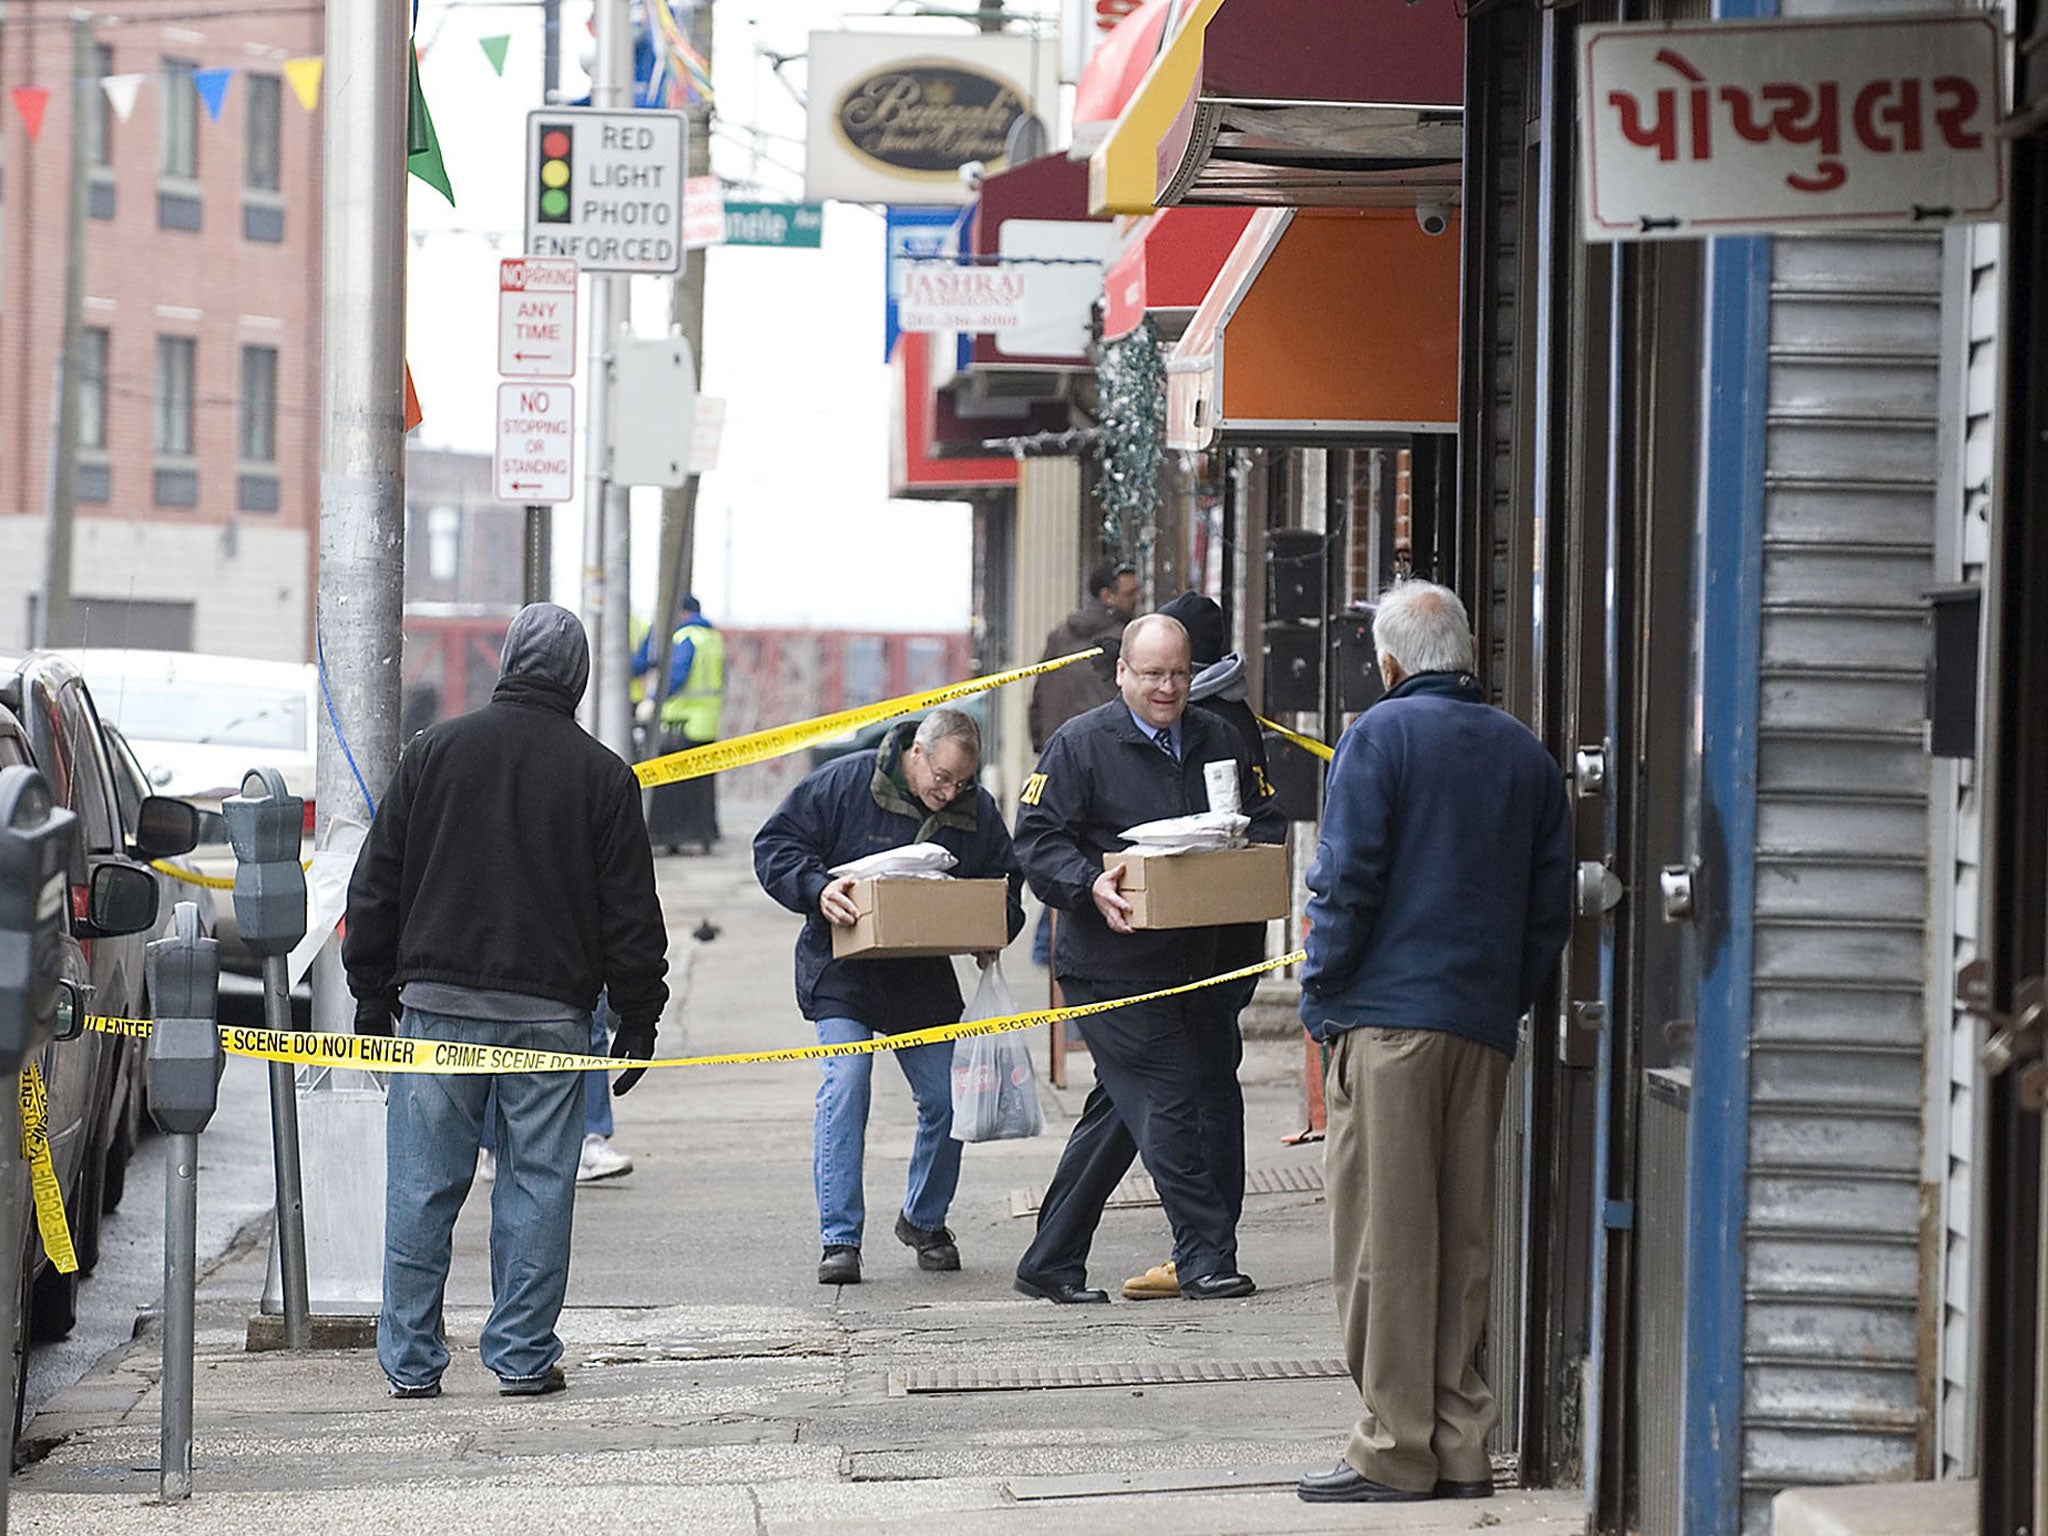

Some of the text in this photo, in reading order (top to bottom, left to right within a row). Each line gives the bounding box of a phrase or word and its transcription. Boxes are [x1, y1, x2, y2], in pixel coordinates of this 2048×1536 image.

[1609, 48, 1983, 192] પોપ્યુલર
[602, 124, 655, 150] RED
[590, 163, 664, 188] LIGHT
[582, 199, 671, 226] PHOTO
[533, 234, 673, 262] ENFORCED
[502, 263, 575, 287] NO PARKING
[903, 272, 1025, 299] JASHRAJ
[517, 302, 557, 318] ANY
[514, 322, 561, 339] TIME
[520, 391, 551, 413] NO
[503, 418, 568, 434] STOPPING
[525, 439, 545, 454] OR
[503, 459, 567, 475] STANDING
[233, 1030, 289, 1053] SCENE
[294, 1035, 316, 1054] DO
[322, 1036, 355, 1058] NOT
[360, 1038, 415, 1064] ENTER
[435, 1043, 487, 1067] CRIME
[490, 1049, 545, 1069] SCENE
